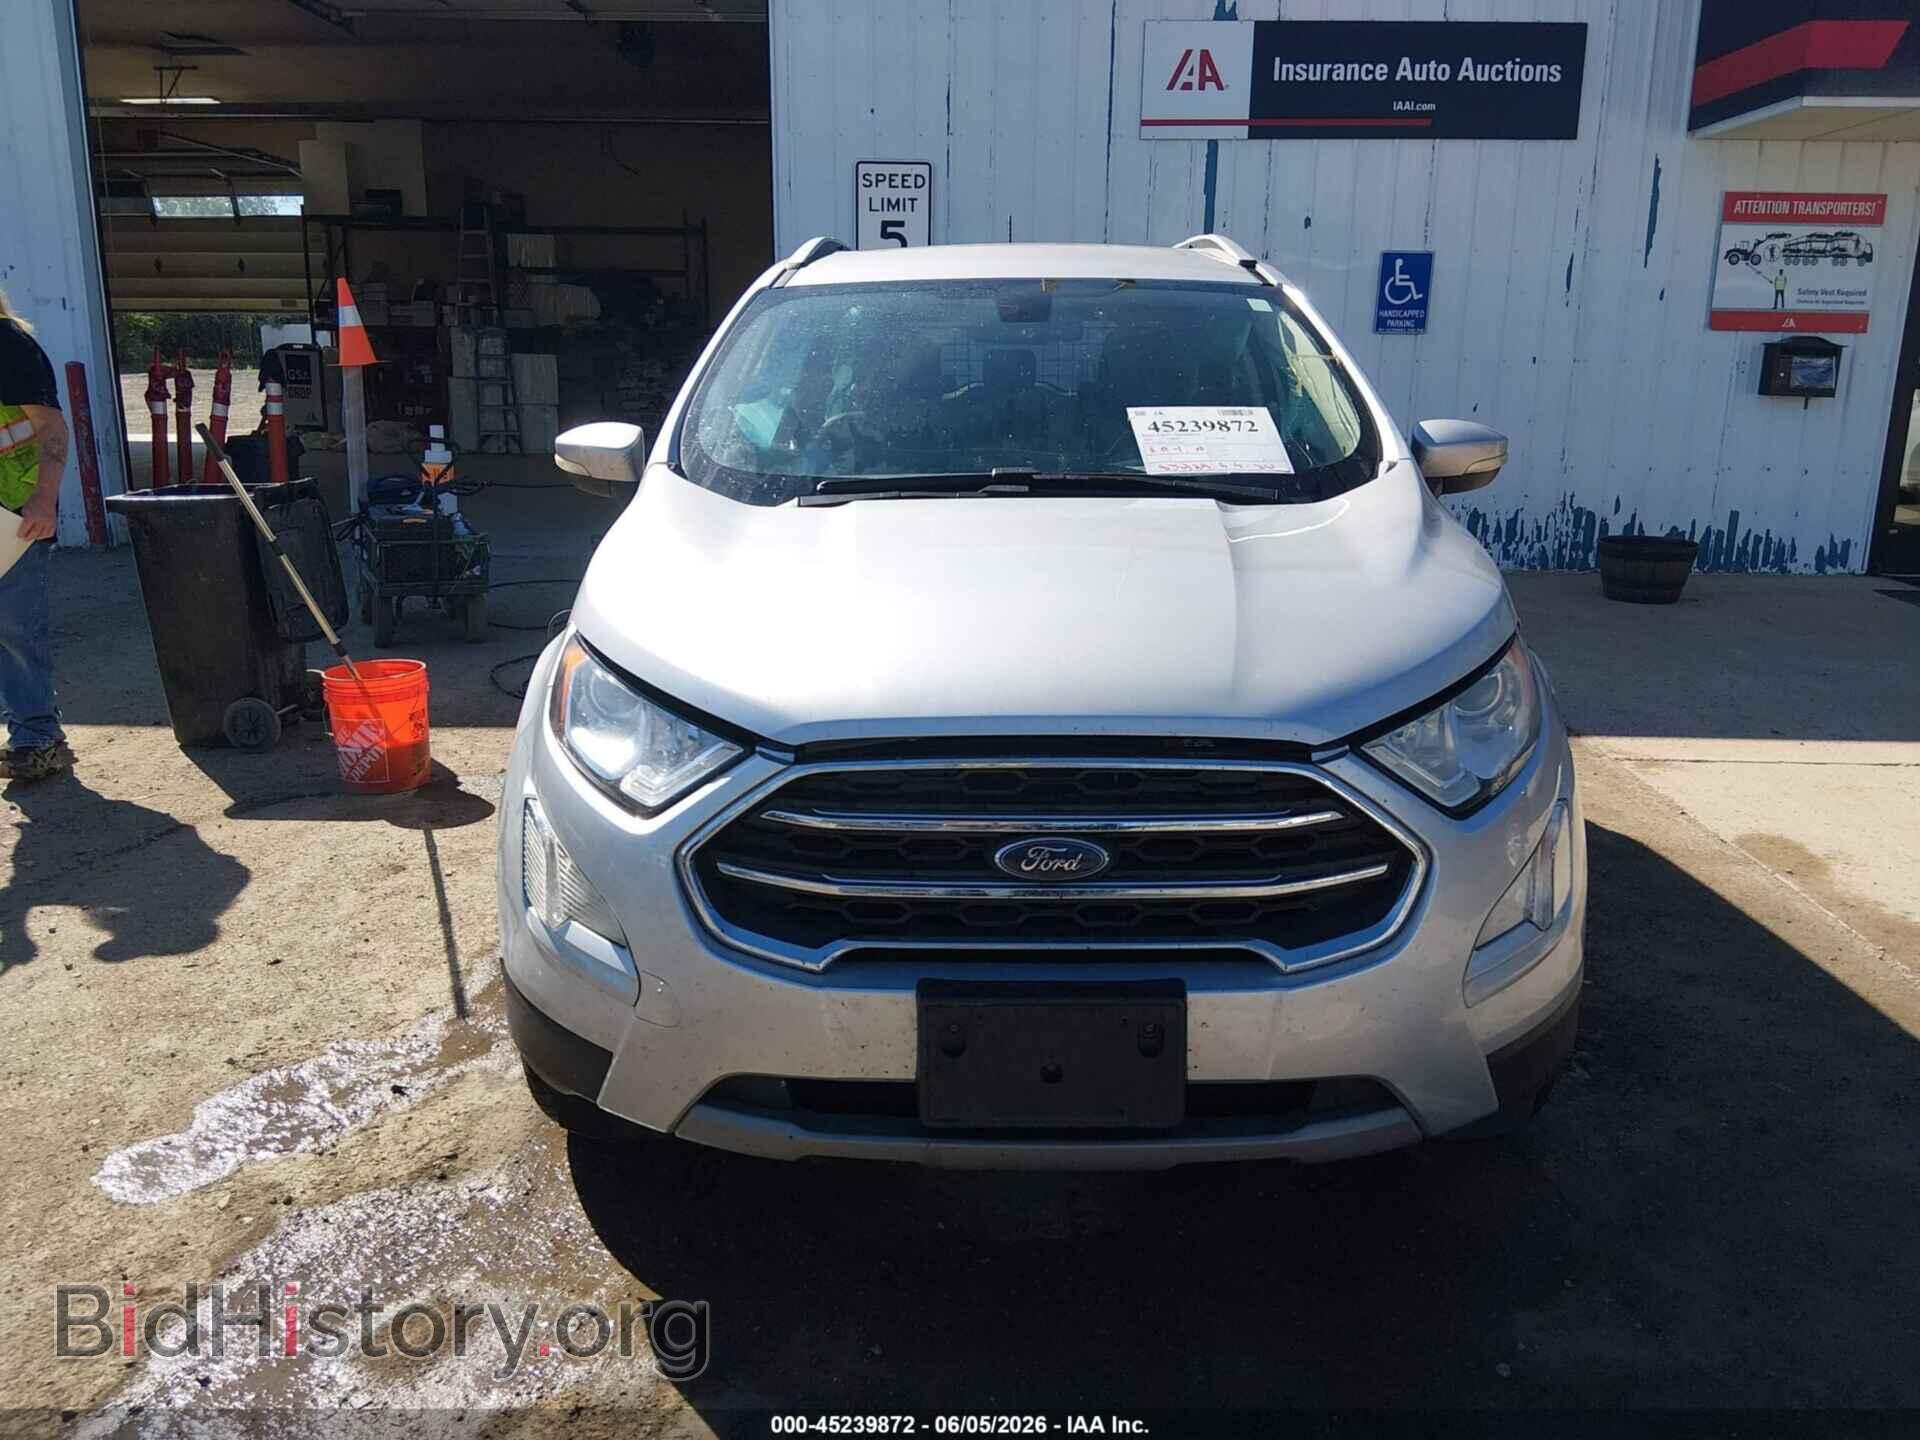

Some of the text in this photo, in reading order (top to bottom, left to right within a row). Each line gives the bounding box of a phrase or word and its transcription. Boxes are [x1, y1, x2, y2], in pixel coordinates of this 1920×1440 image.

[1272, 56, 1562, 83] Insurance Auto Auctions
[1392, 101, 1436, 112] IAAI.com
[862, 172, 926, 189] SPEED
[868, 197, 919, 213] LIMIT
[1733, 199, 1876, 217] ATTENTION TRANSPORTERS!
[1836, 288, 1868, 299] Required
[1378, 308, 1425, 318] HANDICAPPED
[1386, 319, 1416, 328] PARKING
[1147, 420, 1258, 433] 45239872
[1020, 846, 1083, 871] Ford
